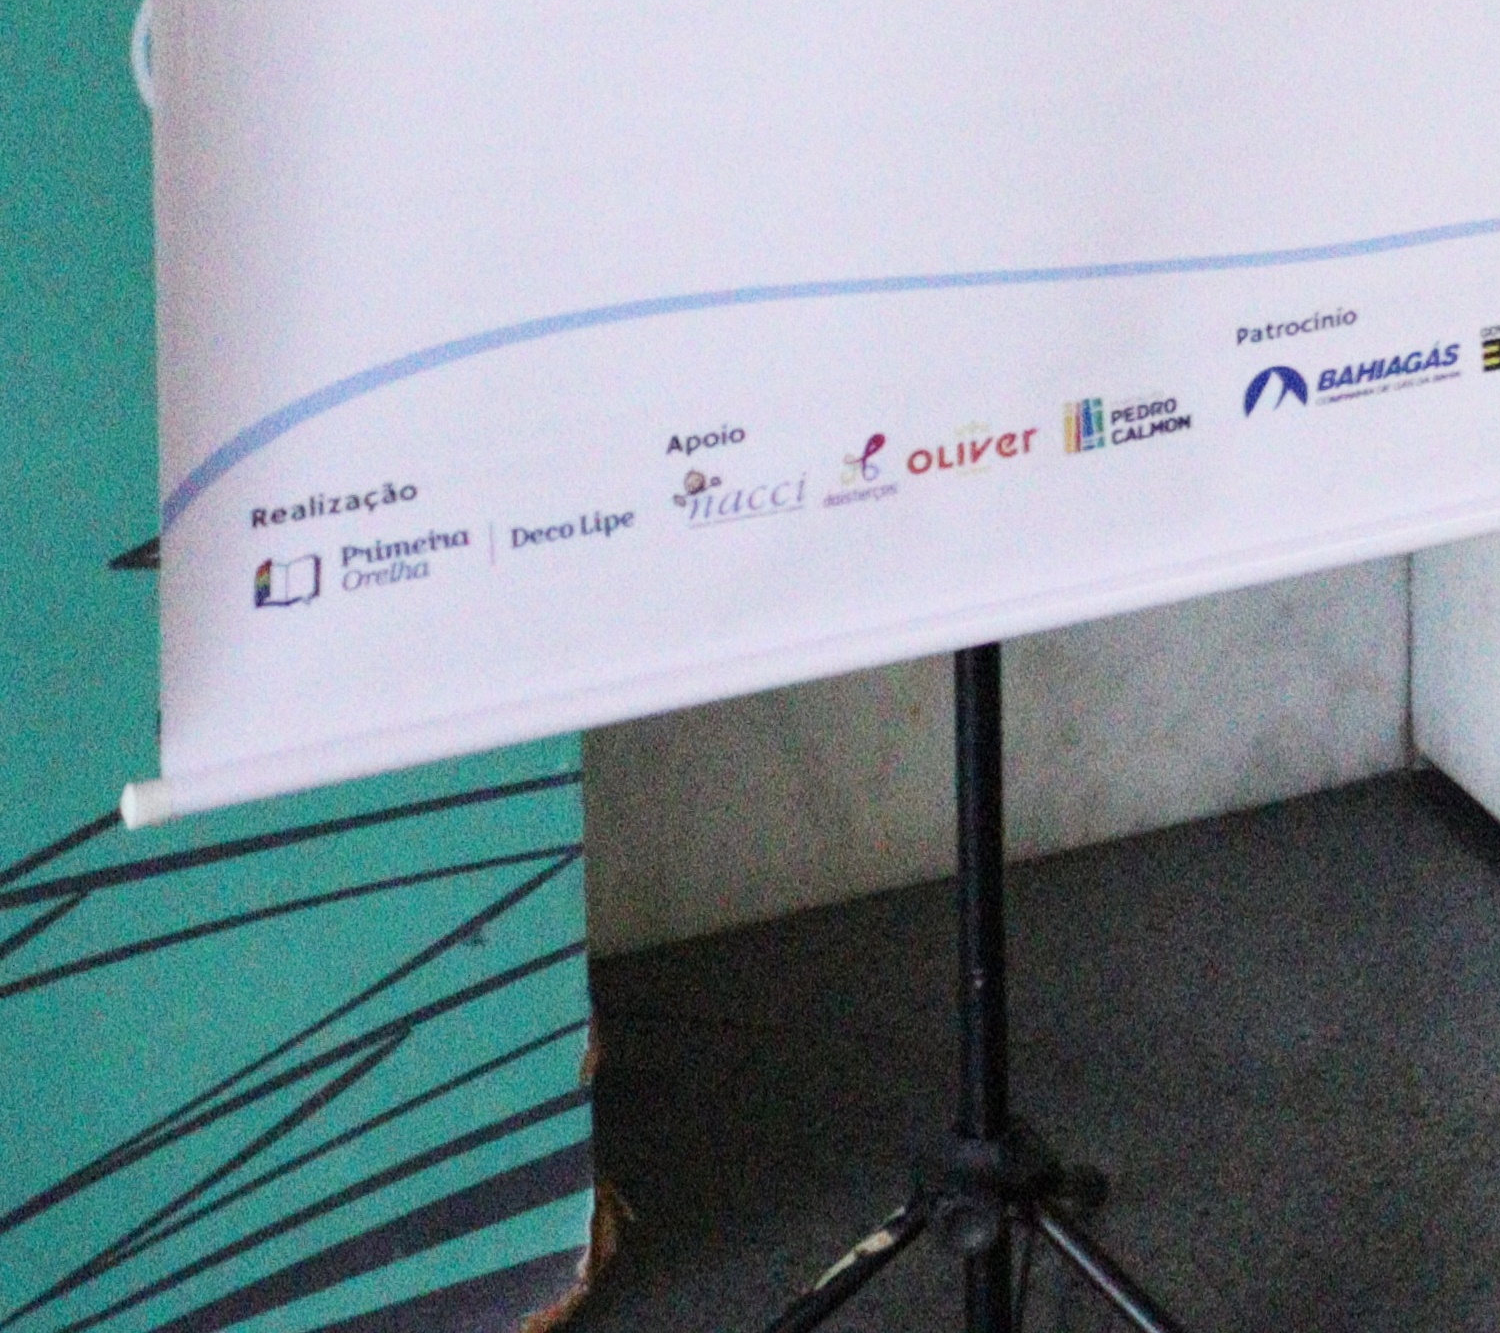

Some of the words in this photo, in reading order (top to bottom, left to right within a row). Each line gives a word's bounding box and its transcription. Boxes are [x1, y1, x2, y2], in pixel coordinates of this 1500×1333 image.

[1236, 306, 1359, 346] Patrocínio
[1316, 340, 1461, 393] BAHIAGÁS
[1111, 397, 1178, 424] PEDRO
[1112, 414, 1192, 446] CALMON
[666, 425, 747, 457] Apoio
[251, 480, 419, 530] Realização
[688, 471, 807, 521] nacci
[341, 529, 471, 567] Primeira
[510, 522, 576, 550] Deco
[579, 510, 636, 539] Lipe
[342, 558, 431, 592] Orelha
